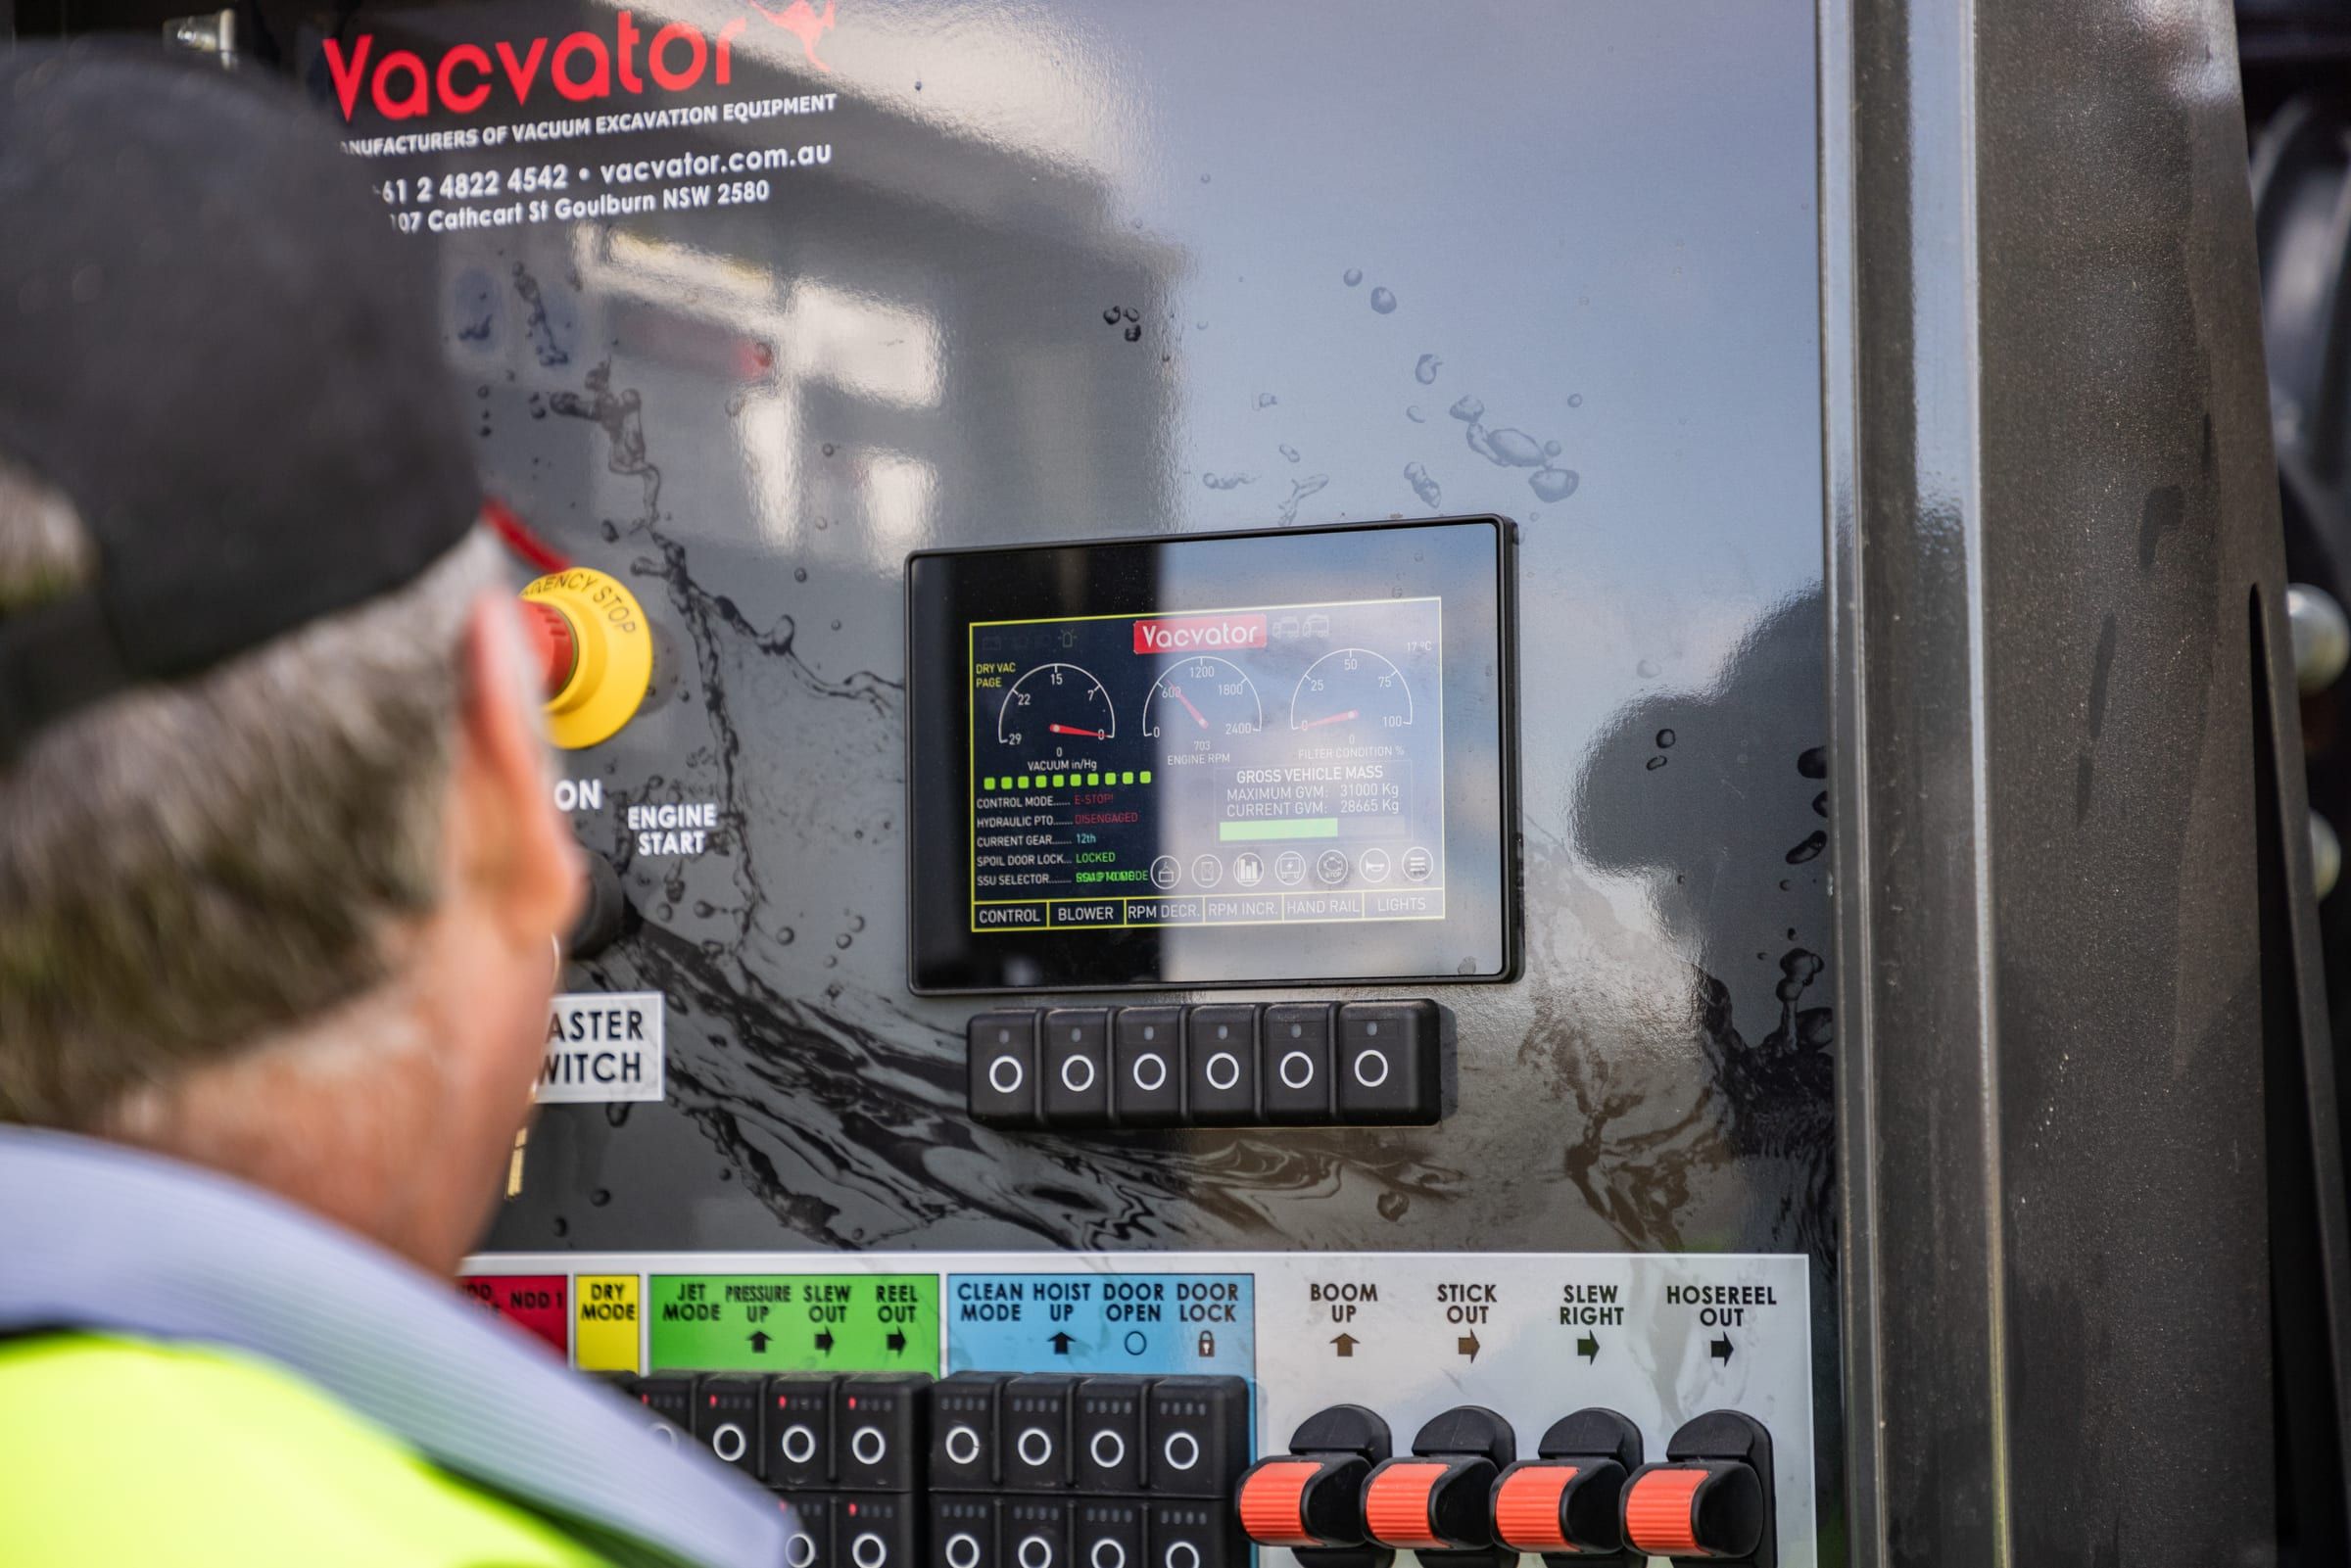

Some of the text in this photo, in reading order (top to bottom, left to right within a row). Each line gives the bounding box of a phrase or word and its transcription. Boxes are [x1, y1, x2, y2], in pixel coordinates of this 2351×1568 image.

[322, 11, 746, 123] Vacvator
[341, 93, 837, 157] ANUFACTURERS OF VACUUM EXCAVATION EQUIPMENT
[417, 176, 433, 203] 2
[439, 169, 501, 200] 4822
[506, 163, 569, 193] 4542
[600, 144, 832, 184] vacvator.com.au
[428, 201, 523, 232] Cathcart
[529, 199, 549, 223] St
[554, 192, 656, 219] Goulburn
[662, 185, 710, 210] NSW
[717, 180, 770, 206] 2580
[592, 586, 637, 634] STOP
[1142, 622, 1258, 647] Vacvator
[976, 662, 1016, 675] DRY VAC
[1190, 665, 1215, 679] 1200
[1344, 658, 1358, 671] 50
[976, 677, 1002, 689] PAGE
[1051, 674, 1063, 686] 15
[1311, 679, 1324, 691] 25
[1378, 676, 1392, 689] 75
[1087, 689, 1094, 701] 7
[1218, 683, 1243, 696] 1800
[1018, 693, 1032, 706] 22
[1225, 723, 1252, 736] 2400
[1301, 720, 1309, 731] 0
[1382, 716, 1403, 729] 100
[1008, 734, 1022, 745] 29
[1097, 729, 1105, 740] 0
[1153, 727, 1161, 738] 0
[1056, 747, 1063, 757] 0
[1193, 740, 1211, 752] 703
[1298, 748, 1334, 761] FILTER
[1335, 745, 1393, 759] CONDITION
[1028, 759, 1097, 772] VACUUM in/Hg
[1168, 753, 1230, 766] ENGINE RPM
[1237, 765, 1383, 784] GROSS VEHICLE MASS
[1226, 783, 1399, 801] MAXIMUM GVM: 31000 Kg
[977, 797, 1023, 809] CONTROL
[1226, 799, 1399, 817] CURRENT GVM: 28665 Kg
[627, 803, 717, 831] ENGINE
[977, 815, 1032, 829] HYDRAULIC
[1075, 812, 1138, 825] DISENGAGED
[638, 831, 705, 856] START
[977, 835, 1024, 848] CURRENT
[1076, 833, 1096, 844] 12th
[977, 855, 1005, 867] SPOIL
[1007, 854, 1035, 866] DOOR
[1076, 852, 1116, 864] LOCKED
[977, 875, 996, 885] SSU
[1128, 904, 1200, 920] RPM DECR.
[1209, 901, 1277, 917] RPM INCR.
[1287, 898, 1360, 915] HAND RAIL
[1377, 896, 1427, 912] LIGHTS
[980, 909, 1040, 924] CONTROL
[1058, 906, 1114, 922] BLOWER
[546, 1010, 644, 1043] ASTER
[510, 1291, 551, 1309] NDD
[590, 1283, 625, 1301] DRY
[678, 1283, 706, 1302] JET
[726, 1284, 792, 1303] PRESSURE
[803, 1284, 851, 1303] SLEW
[876, 1284, 919, 1304] REEL
[957, 1282, 1024, 1302] CLEAN
[1032, 1282, 1091, 1302] HOIST
[1103, 1282, 1165, 1302] DOOR
[1176, 1282, 1239, 1302] DOOR
[1310, 1283, 1379, 1303] BOOM
[1437, 1283, 1498, 1304] STICK
[1563, 1285, 1619, 1305] SLEW
[1666, 1286, 1778, 1306] HOSEREEL
[582, 1304, 636, 1321] MODE
[663, 1304, 722, 1322] MODE
[747, 1305, 770, 1323] UP
[808, 1305, 847, 1323] OUT
[878, 1305, 917, 1323] OUT
[961, 1303, 1022, 1322] MODE
[1049, 1303, 1075, 1322] UP
[1106, 1303, 1162, 1323] OPEN
[1179, 1303, 1236, 1323] LOCK
[1331, 1305, 1358, 1324] UP
[1446, 1305, 1490, 1325] OUT
[1559, 1306, 1625, 1326] RIGHT
[1700, 1307, 1744, 1327] OUT
